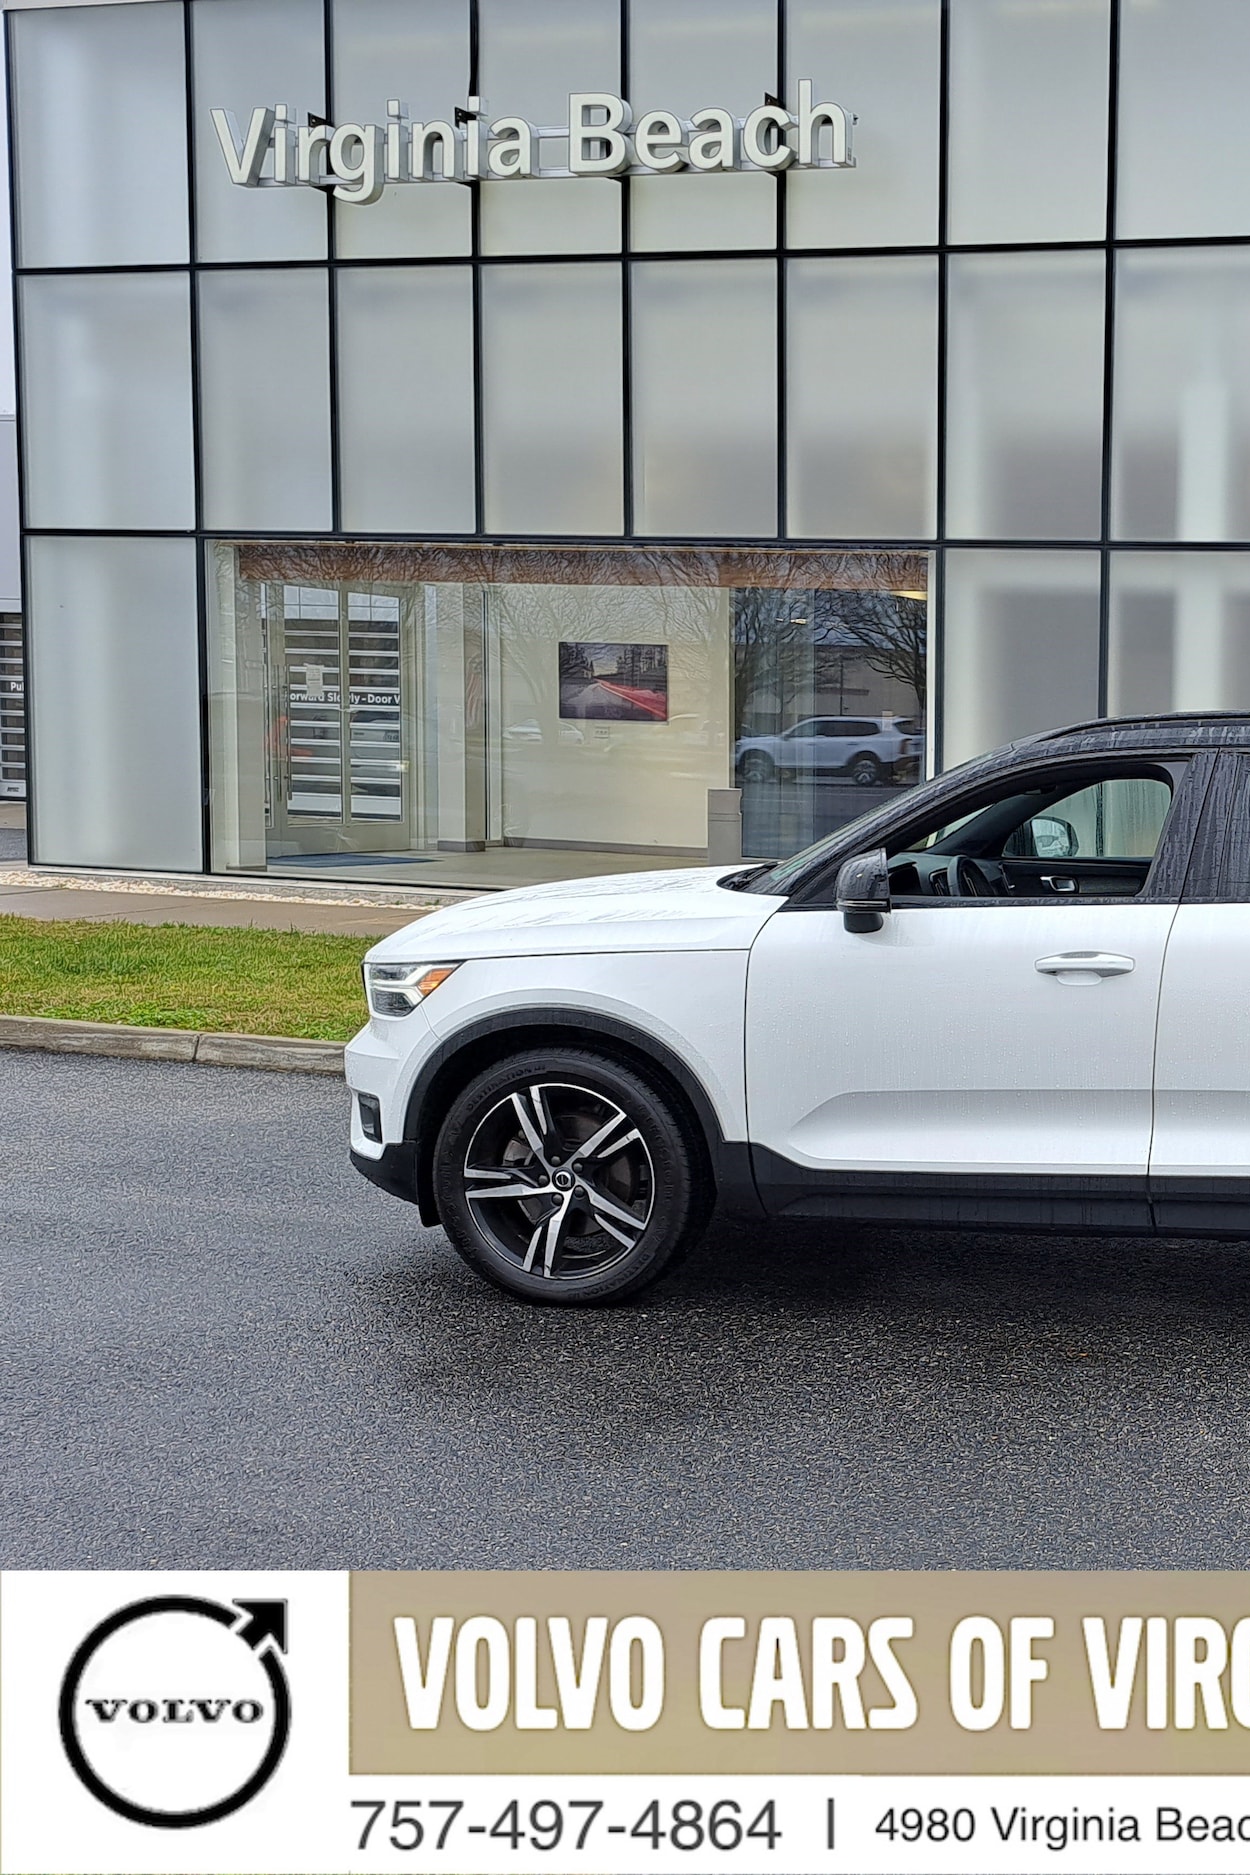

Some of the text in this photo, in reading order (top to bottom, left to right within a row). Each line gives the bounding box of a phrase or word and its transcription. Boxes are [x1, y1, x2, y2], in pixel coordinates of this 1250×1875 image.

[209, 79, 851, 206] Virginia Beach
[367, 694, 392, 703] Door
